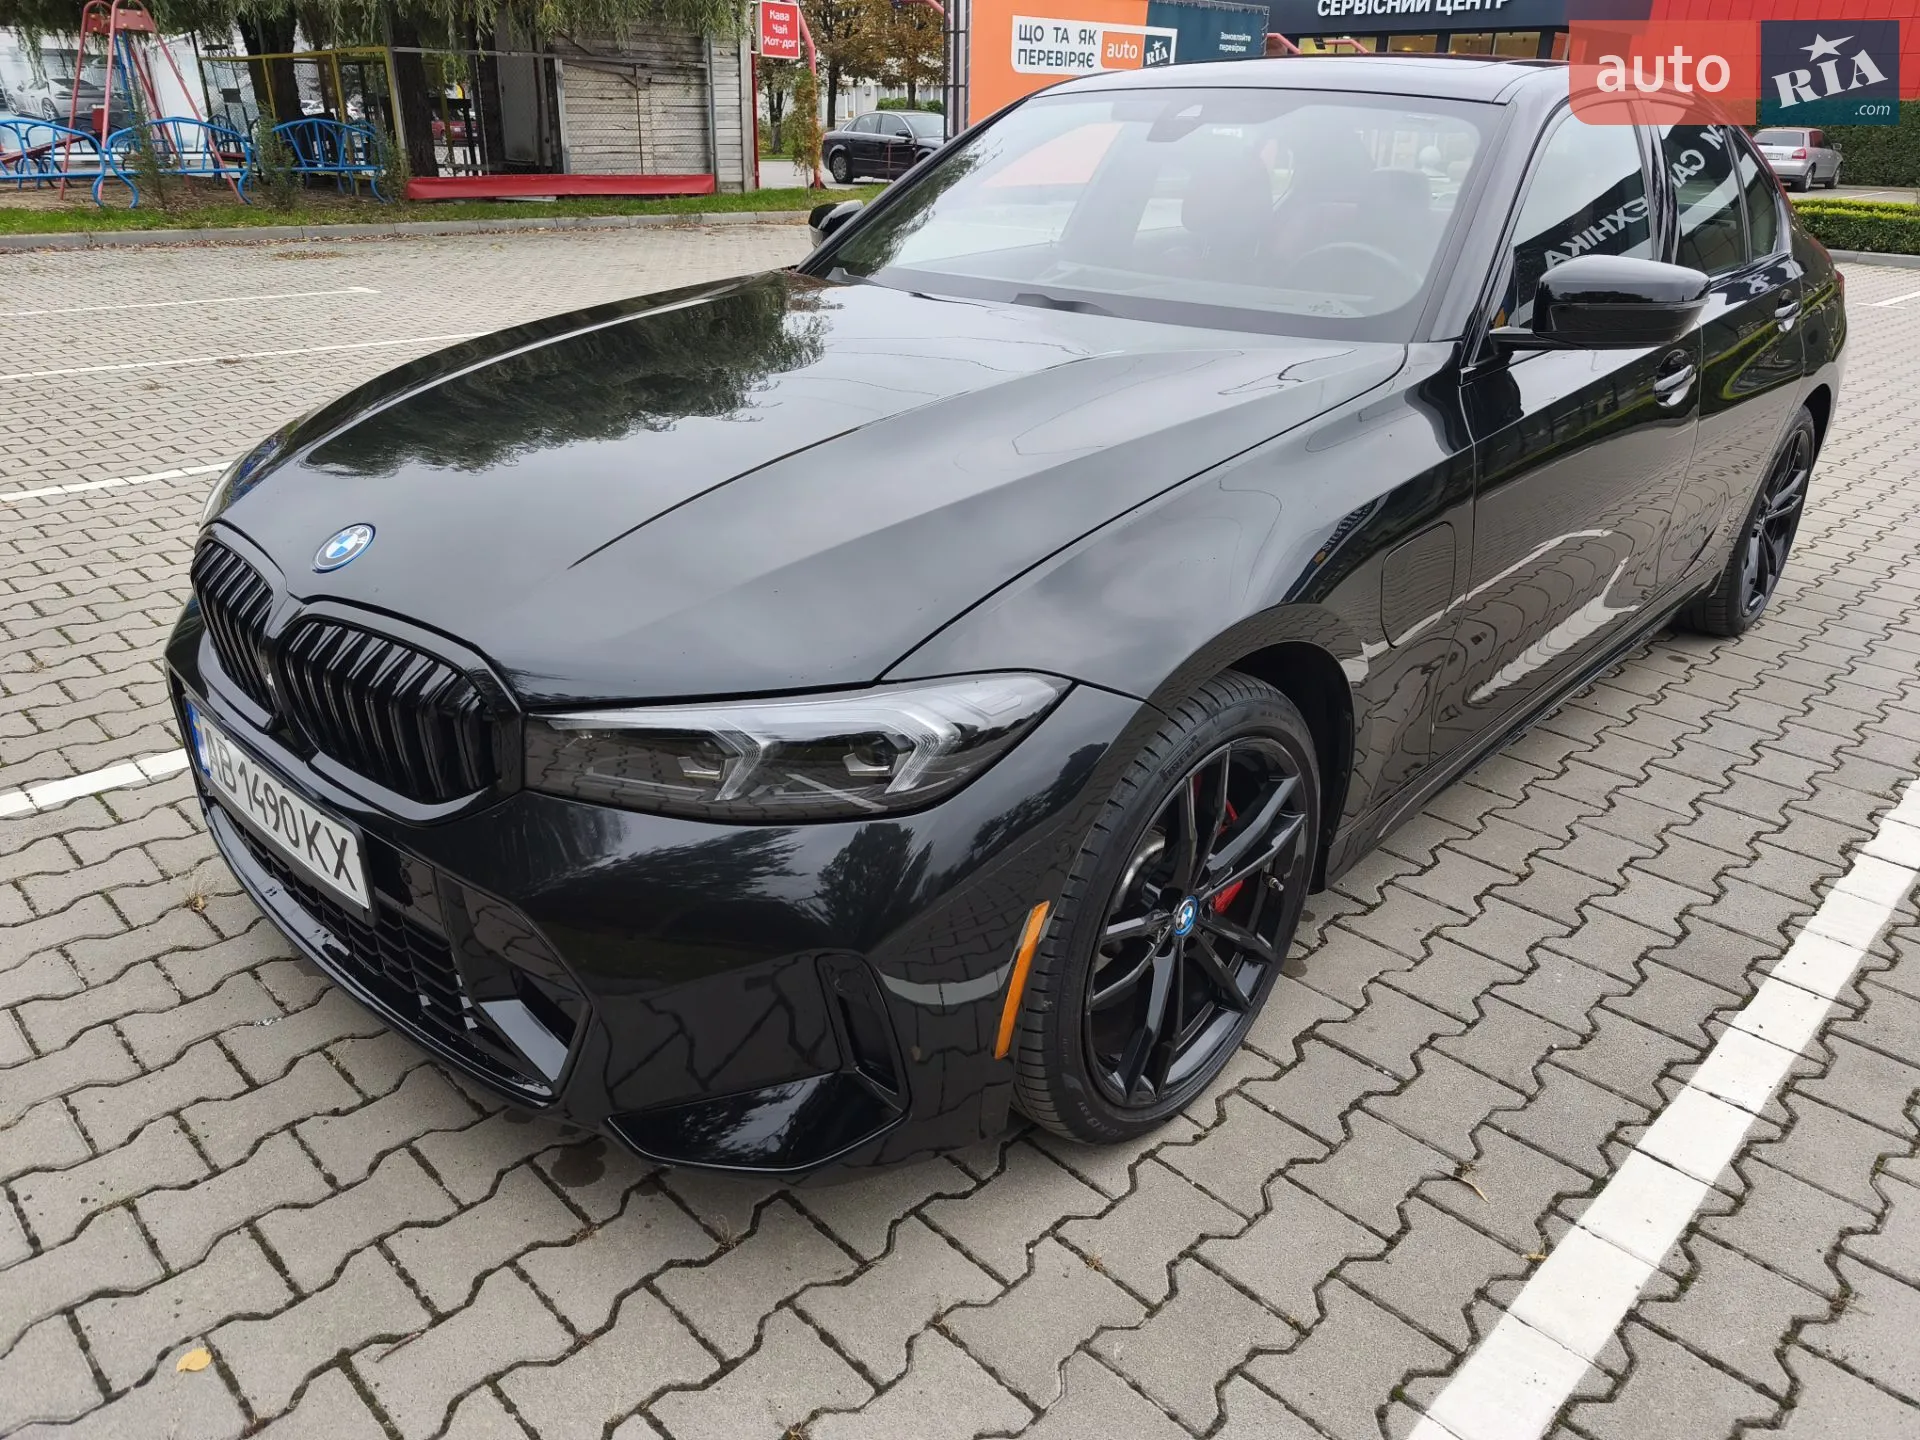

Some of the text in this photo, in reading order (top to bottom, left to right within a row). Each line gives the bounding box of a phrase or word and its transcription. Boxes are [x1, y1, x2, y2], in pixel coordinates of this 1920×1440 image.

[769, 9, 790, 21] Кава
[772, 23, 788, 35] Чай
[1018, 24, 1097, 45] ЩО ТА ЯК
[763, 35, 797, 49] Хот-дог
[1017, 48, 1096, 69] ПЕРЕВІРЯЄ
[1106, 40, 1169, 65] auto RIA
